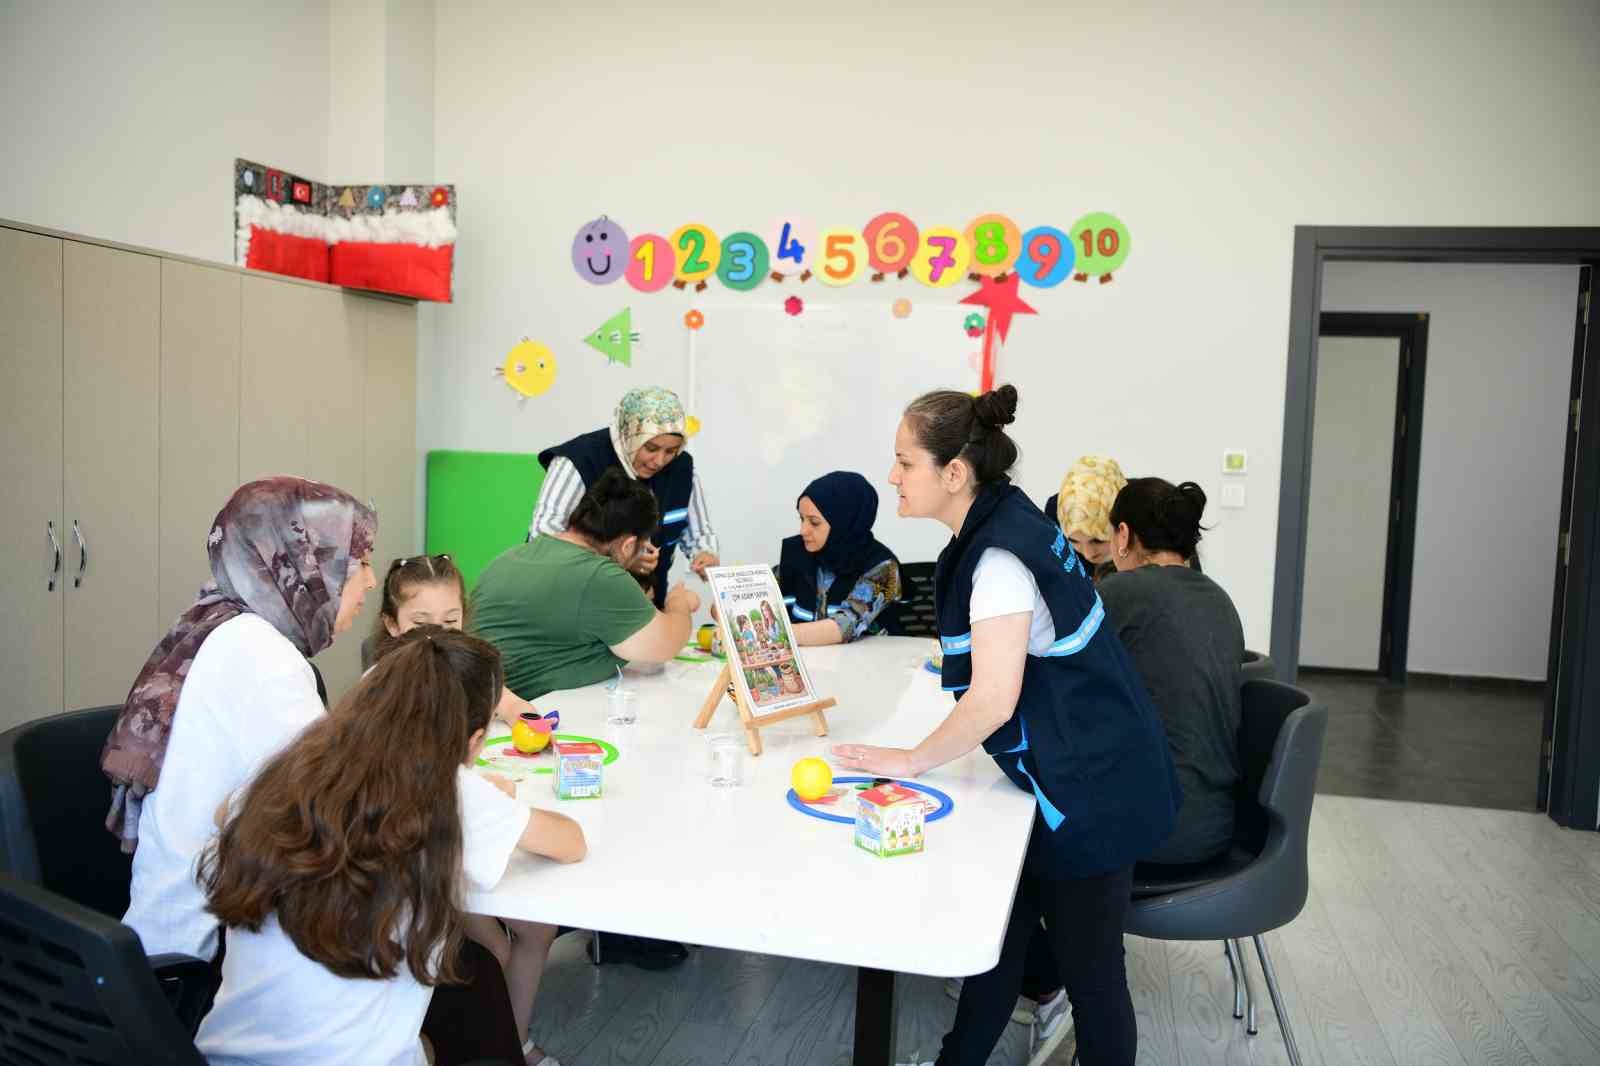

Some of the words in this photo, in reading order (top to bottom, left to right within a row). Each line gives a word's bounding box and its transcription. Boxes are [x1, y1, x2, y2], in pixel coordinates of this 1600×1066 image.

[635, 239, 655, 282] 1
[679, 229, 710, 273] 2
[726, 241, 756, 282] 3
[777, 222, 805, 263] 4
[824, 234, 856, 279] 5
[874, 221, 908, 264] 6
[926, 236, 957, 283] 7
[974, 221, 1009, 266] 8
[1028, 234, 1062, 280] 9
[1079, 228, 1120, 257] 10
